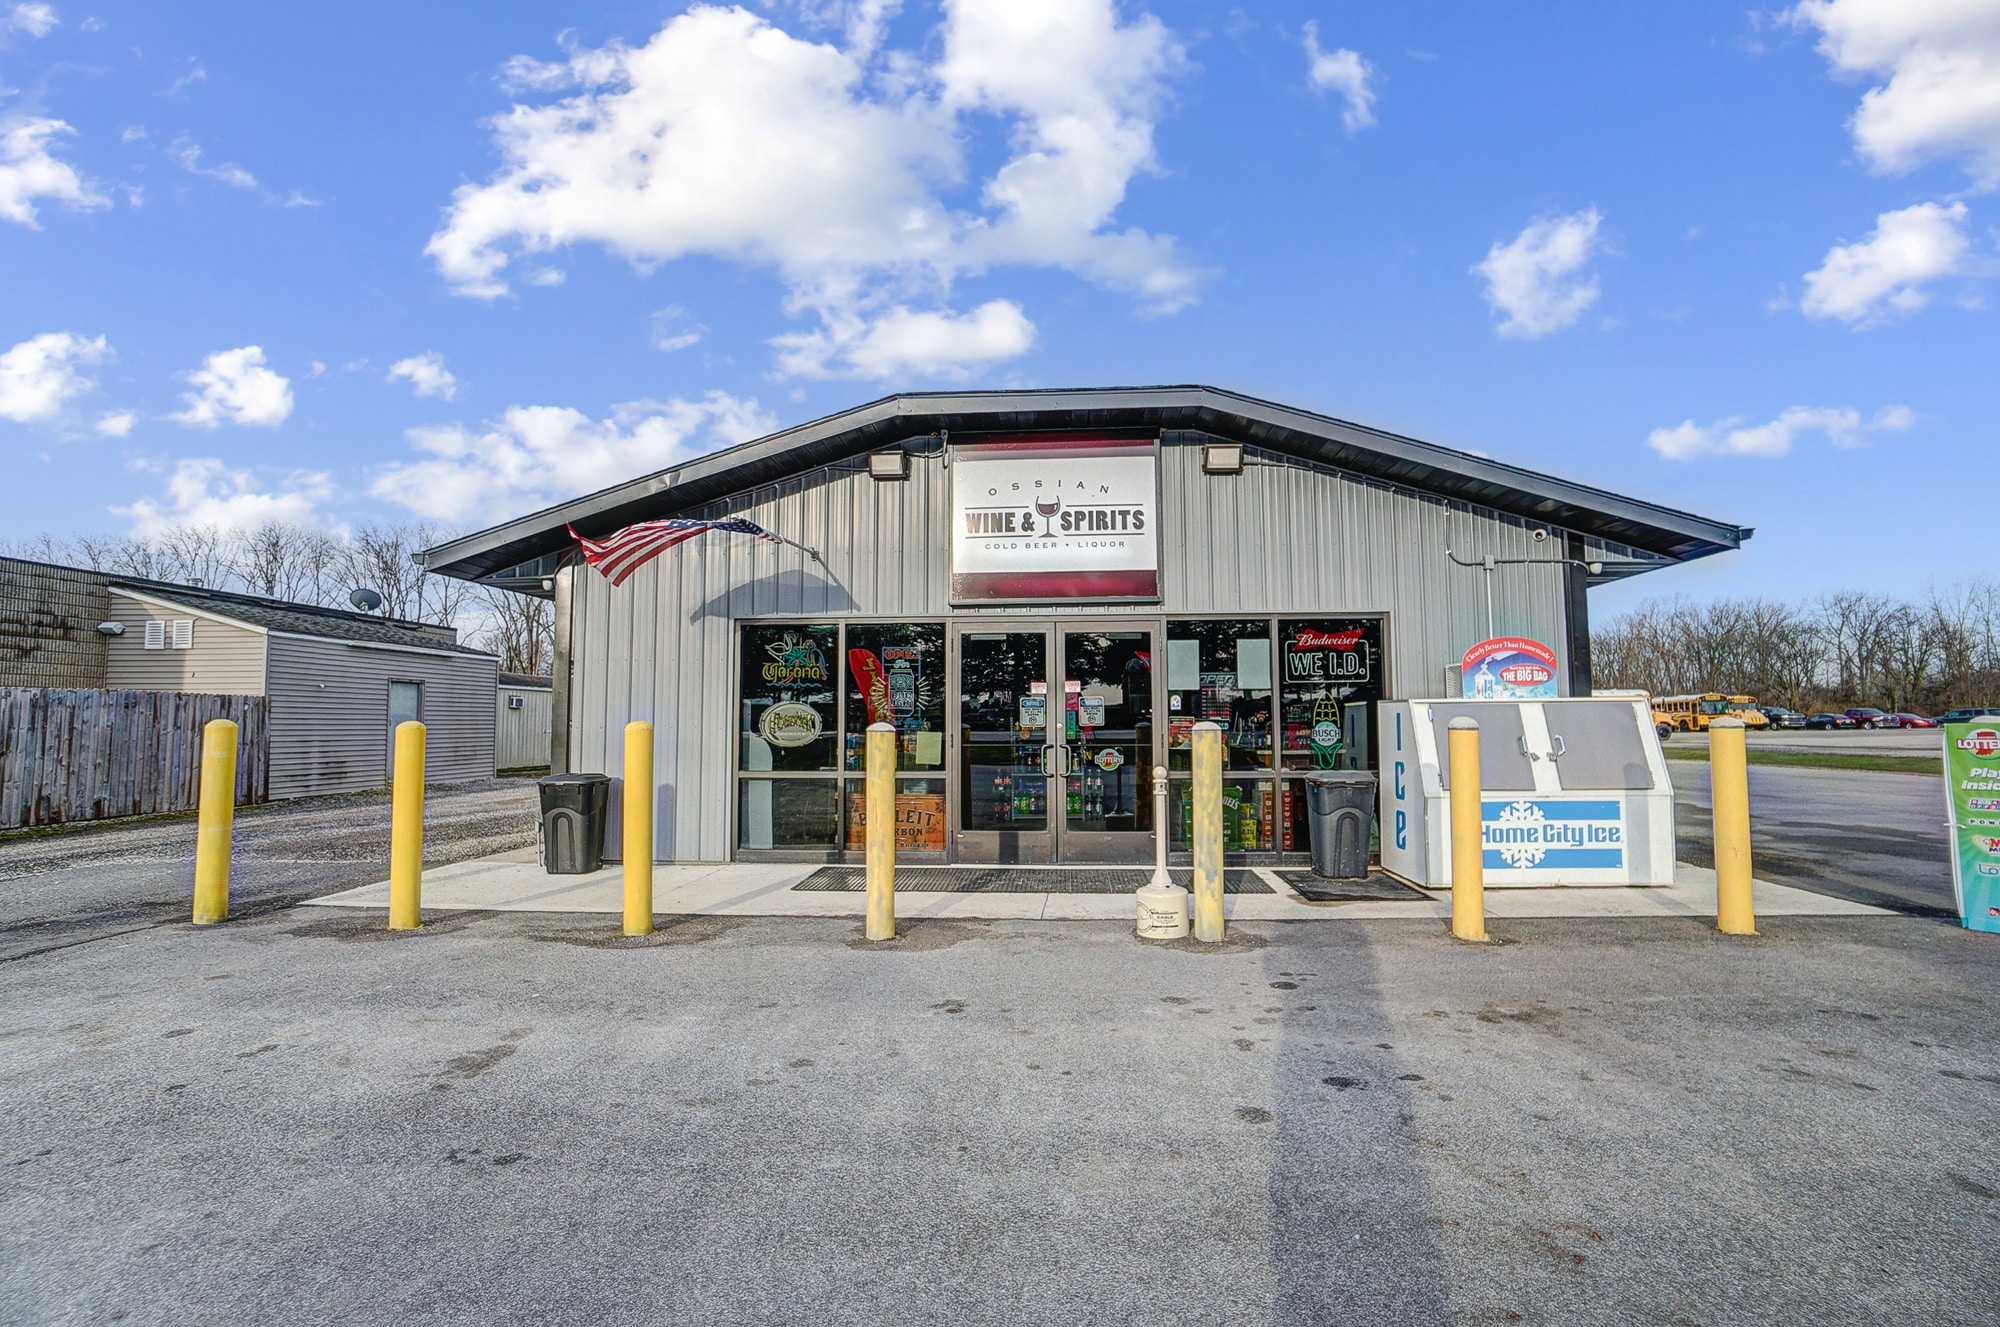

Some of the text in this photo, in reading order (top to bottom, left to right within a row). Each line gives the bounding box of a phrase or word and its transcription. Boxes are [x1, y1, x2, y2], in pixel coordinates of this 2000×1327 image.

[988, 480, 1109, 496] OSSIAN
[965, 509, 1145, 534] WINE & SPIRITS
[1077, 540, 1126, 548] LIQUOR
[1296, 633, 1359, 646] Budweiser
[1466, 647, 1485, 663] Clearly
[1485, 643, 1503, 651] Better
[1289, 652, 1366, 676] WE I.D.
[762, 663, 820, 683] Corona
[1503, 670, 1548, 682] THE BIG BAG
[1312, 729, 1341, 738] BUSCH
[1957, 739, 2000, 749] LOTTE
[1096, 756, 1122, 764] LOTTERY
[859, 808, 936, 826] BLEIT
[1542, 824, 1584, 847] City
[1587, 824, 1621, 843] Ice
